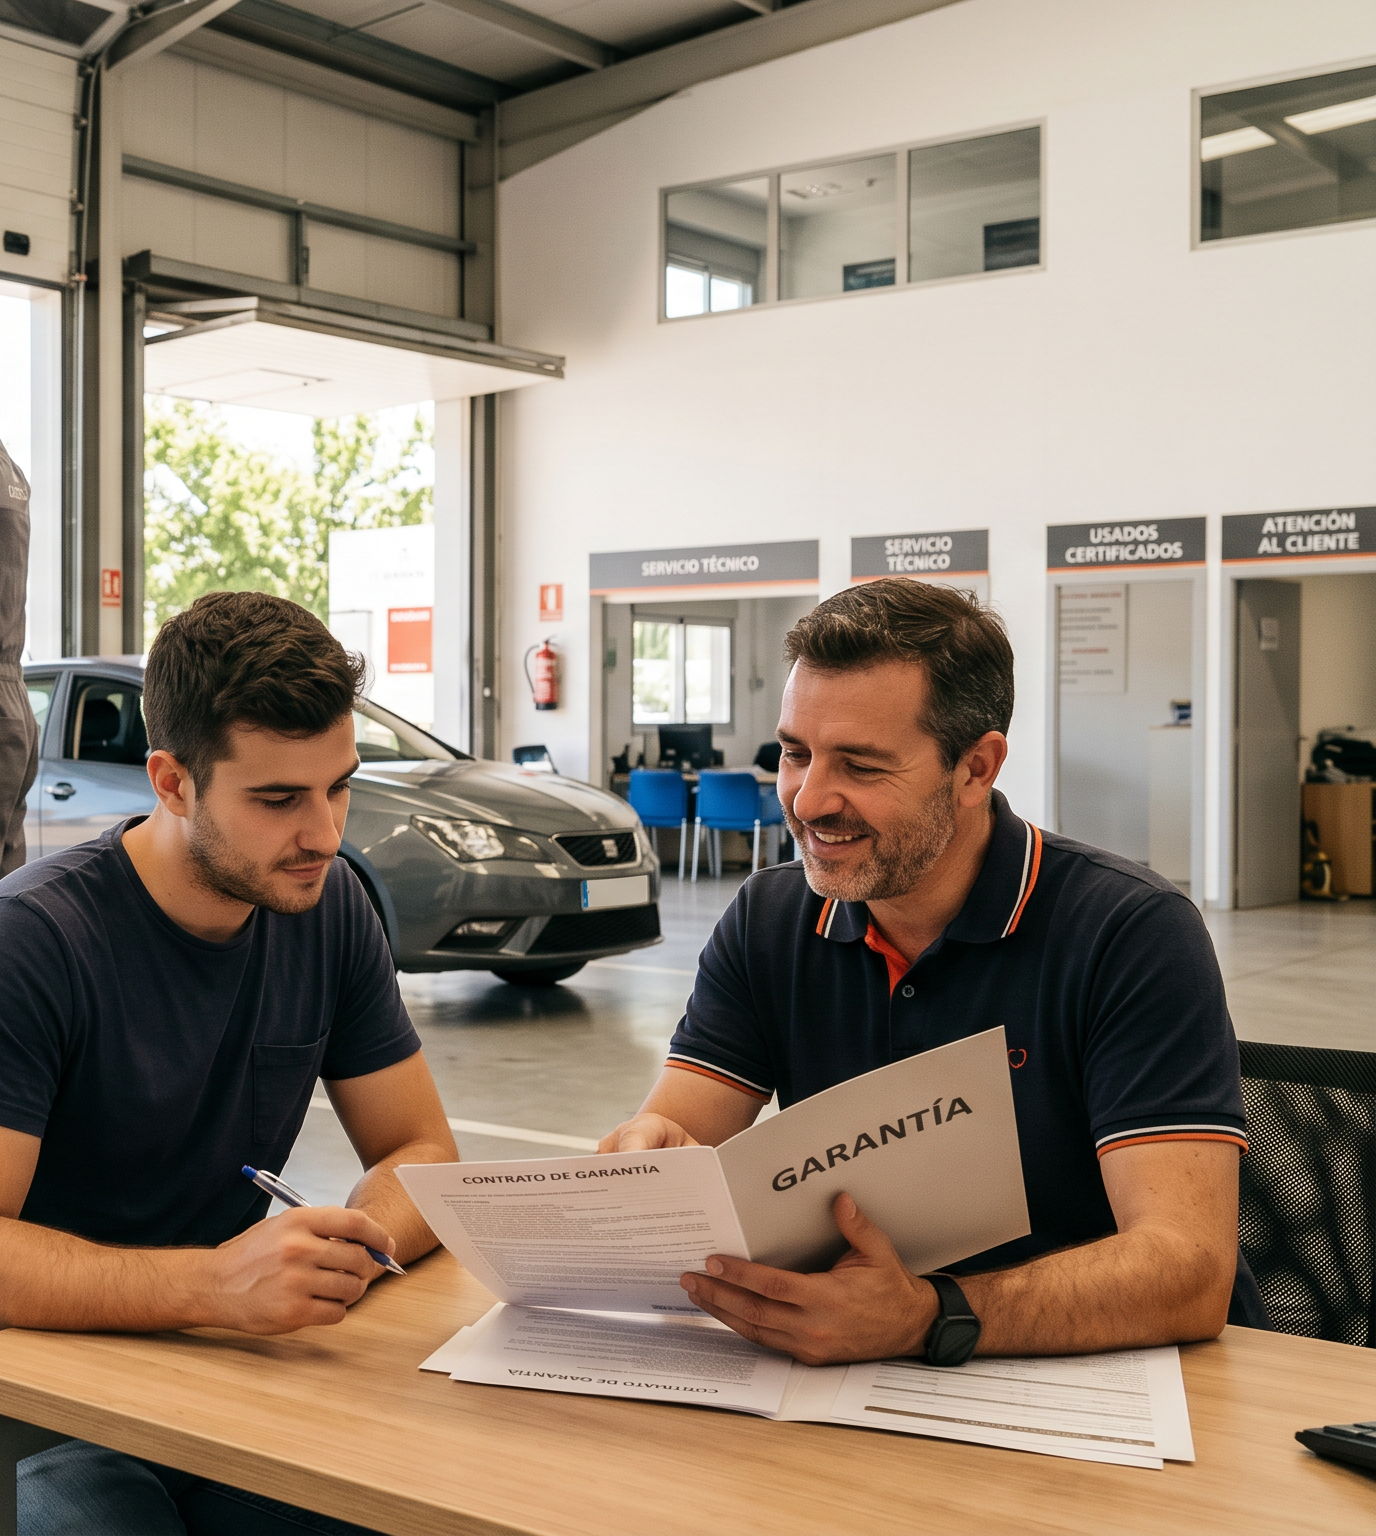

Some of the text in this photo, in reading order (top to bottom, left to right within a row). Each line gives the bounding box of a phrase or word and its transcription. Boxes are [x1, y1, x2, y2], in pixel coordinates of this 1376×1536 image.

[1261, 510, 1356, 534] ATENCIÓN
[1089, 524, 1159, 544] USADOS
[1257, 532, 1360, 554] AL CLIENTE
[884, 536, 953, 555] SERVICIO
[1064, 541, 1184, 563] CERTIFICADOS
[641, 554, 760, 576] SERVICIO TÉCNICO
[886, 553, 951, 571] TÉCNICO
[771, 1096, 973, 1192] GARANTÍA
[462, 1164, 660, 1185] CONTRATO DE GARANTÍA
